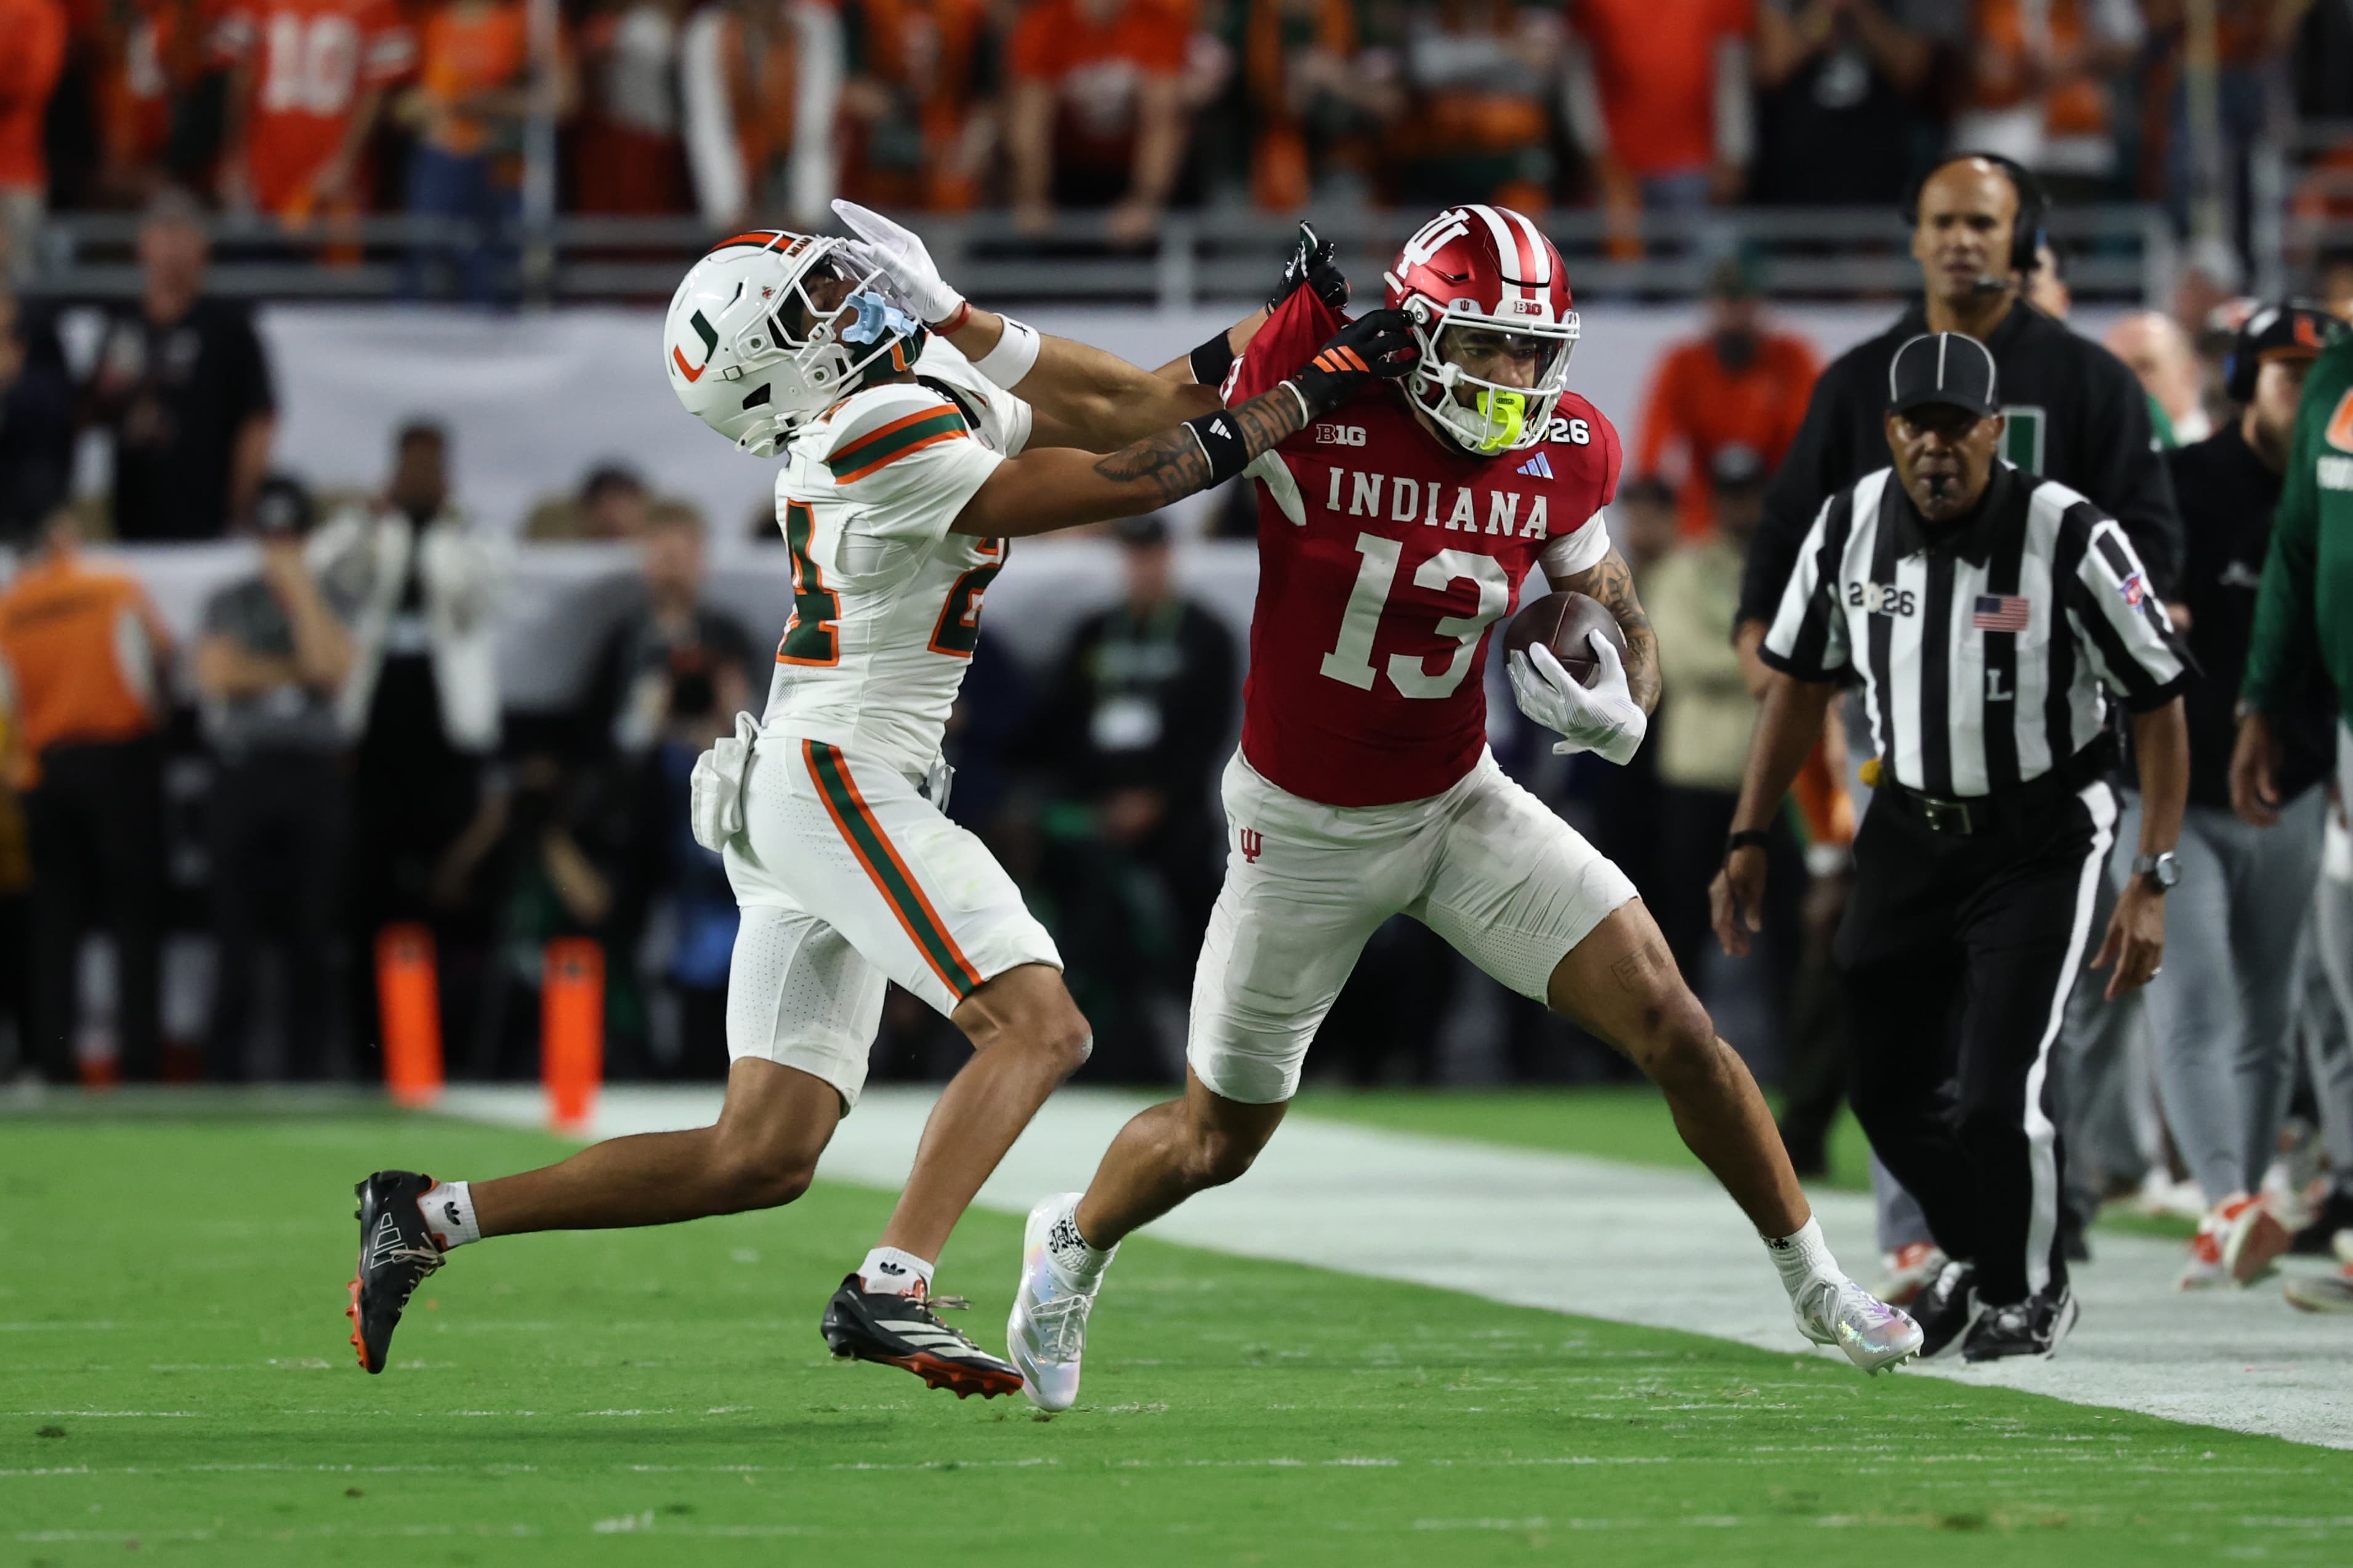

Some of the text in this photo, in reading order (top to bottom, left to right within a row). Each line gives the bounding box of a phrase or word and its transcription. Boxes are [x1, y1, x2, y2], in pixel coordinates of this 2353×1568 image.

[1528, 416, 1590, 446] 26
[1327, 467, 1548, 541] INDIANA
[1320, 532, 1509, 699] 13
[1987, 669, 2012, 701] L
